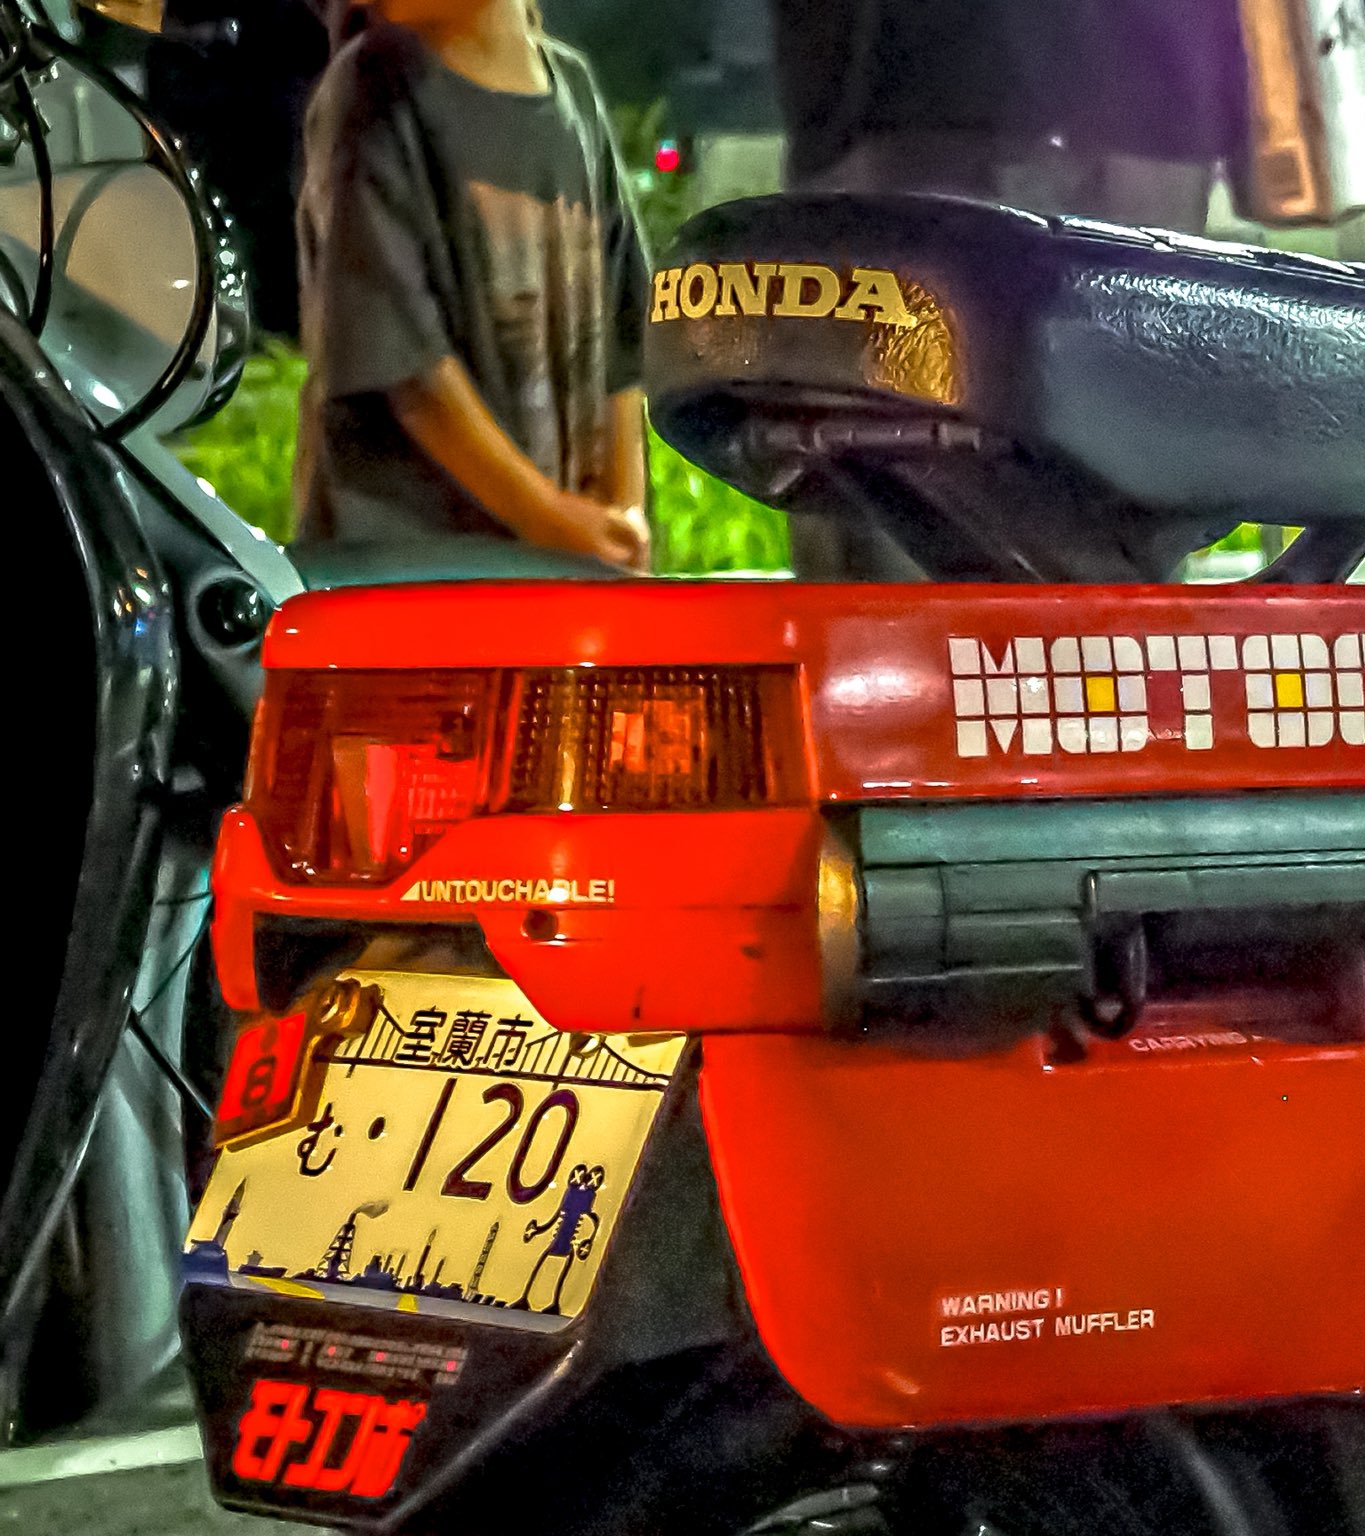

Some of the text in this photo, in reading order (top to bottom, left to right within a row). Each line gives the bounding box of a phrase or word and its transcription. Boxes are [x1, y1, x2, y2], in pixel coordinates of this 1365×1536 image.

[651, 263, 918, 330] HONDA
[395, 1005, 534, 1069] 室蘭市
[940, 1308, 1155, 1347] EXHAUST MUFFLER
